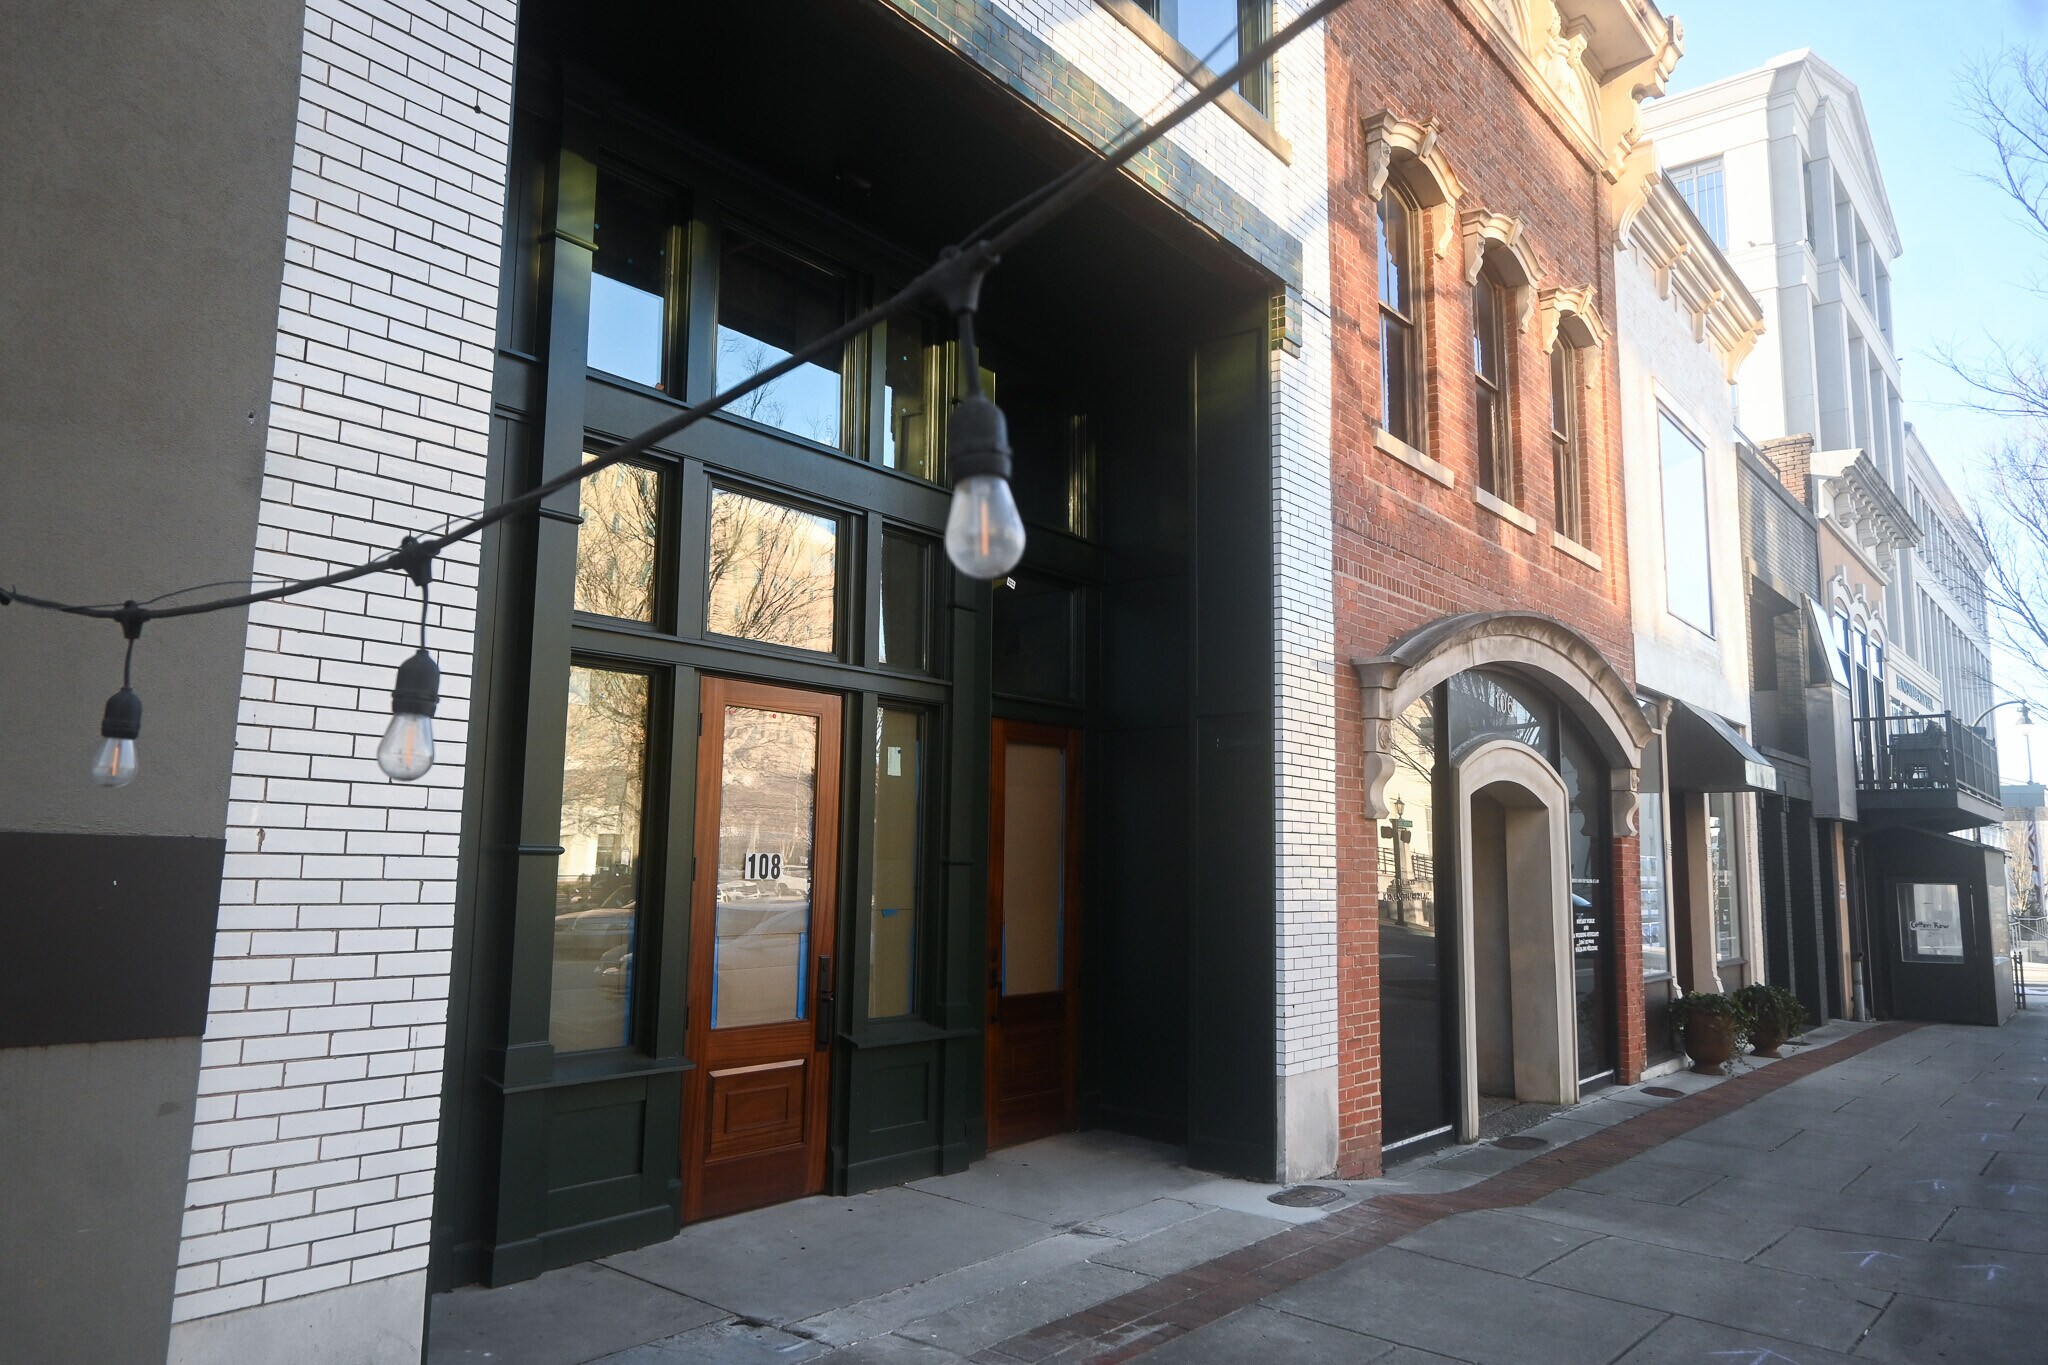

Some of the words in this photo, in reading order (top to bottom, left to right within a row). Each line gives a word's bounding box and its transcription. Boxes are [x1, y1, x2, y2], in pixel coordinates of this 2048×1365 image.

[1496, 691, 1513, 716] 106
[748, 853, 781, 880] 108
[1910, 920, 1931, 929] Cotton
[1933, 921, 1949, 929] Row
